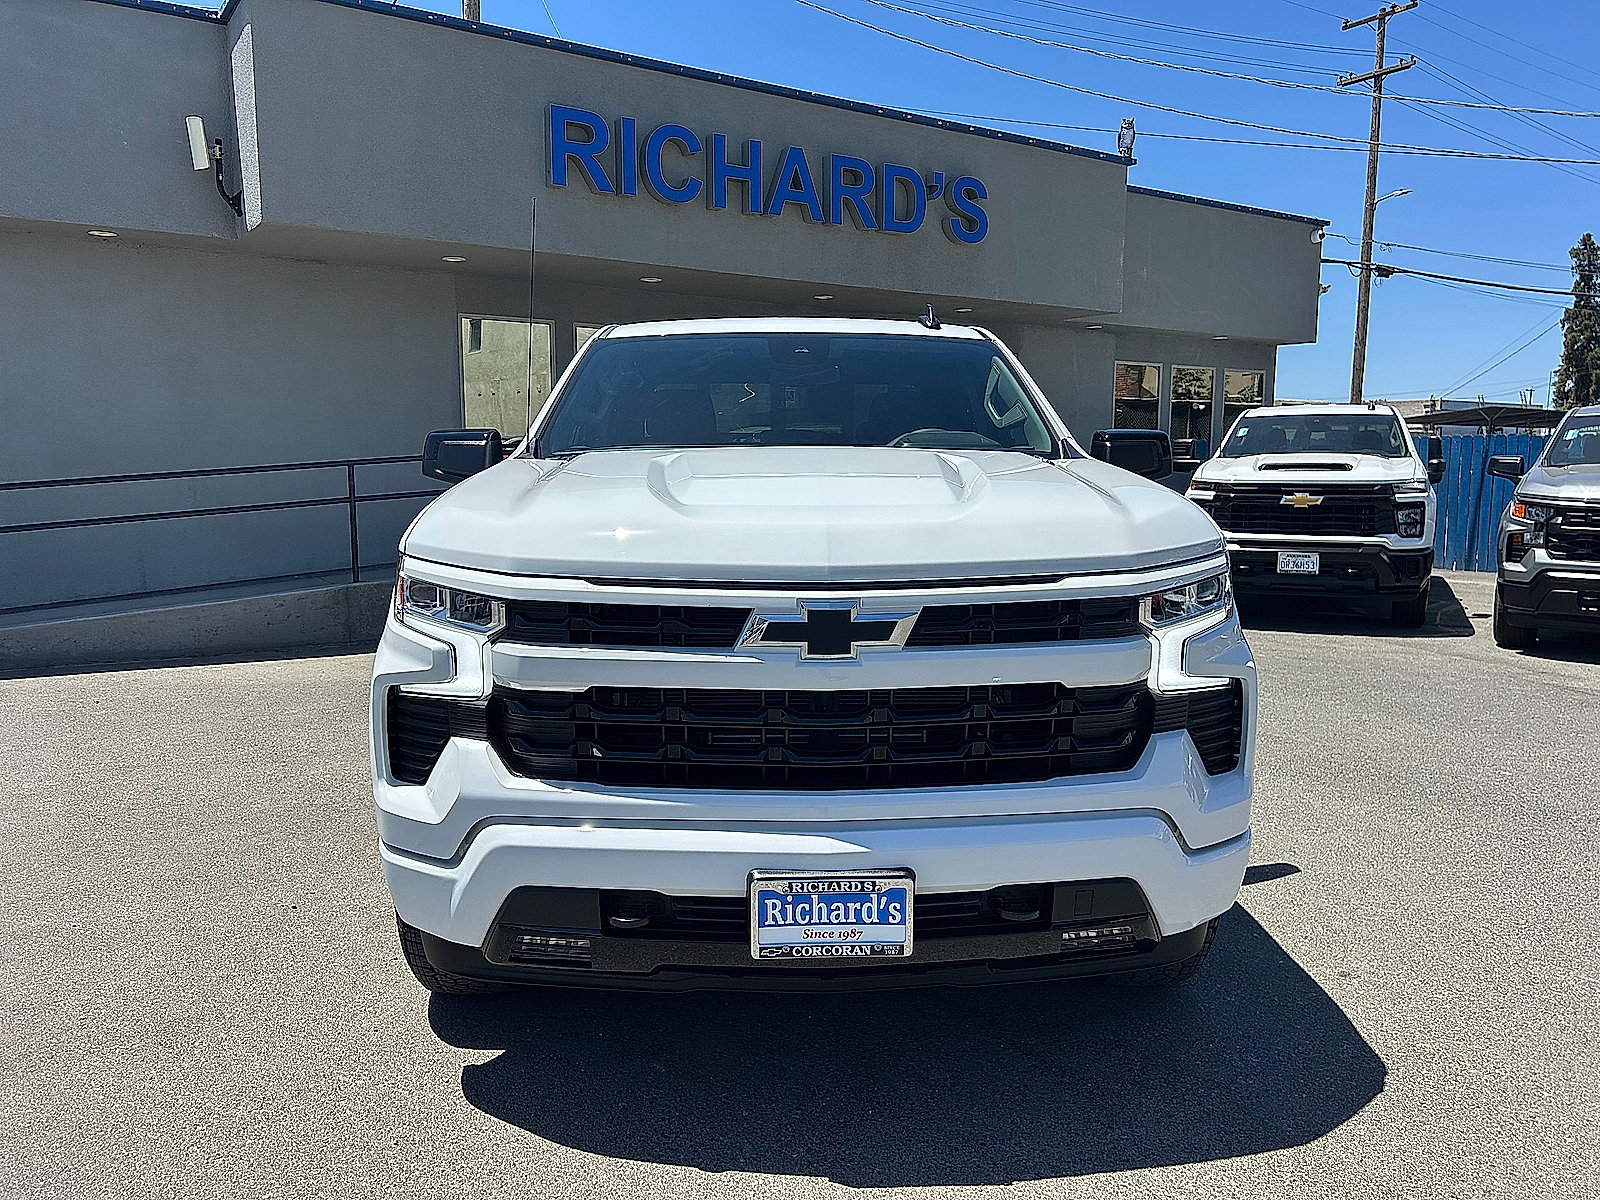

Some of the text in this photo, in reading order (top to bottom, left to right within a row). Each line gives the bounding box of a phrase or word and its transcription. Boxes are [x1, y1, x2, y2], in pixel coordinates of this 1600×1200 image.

[549, 104, 988, 244] RICHARD'S
[764, 894, 902, 925] Richard's
[802, 928, 864, 941] Since 1987
[792, 945, 872, 957] CORCORAN
